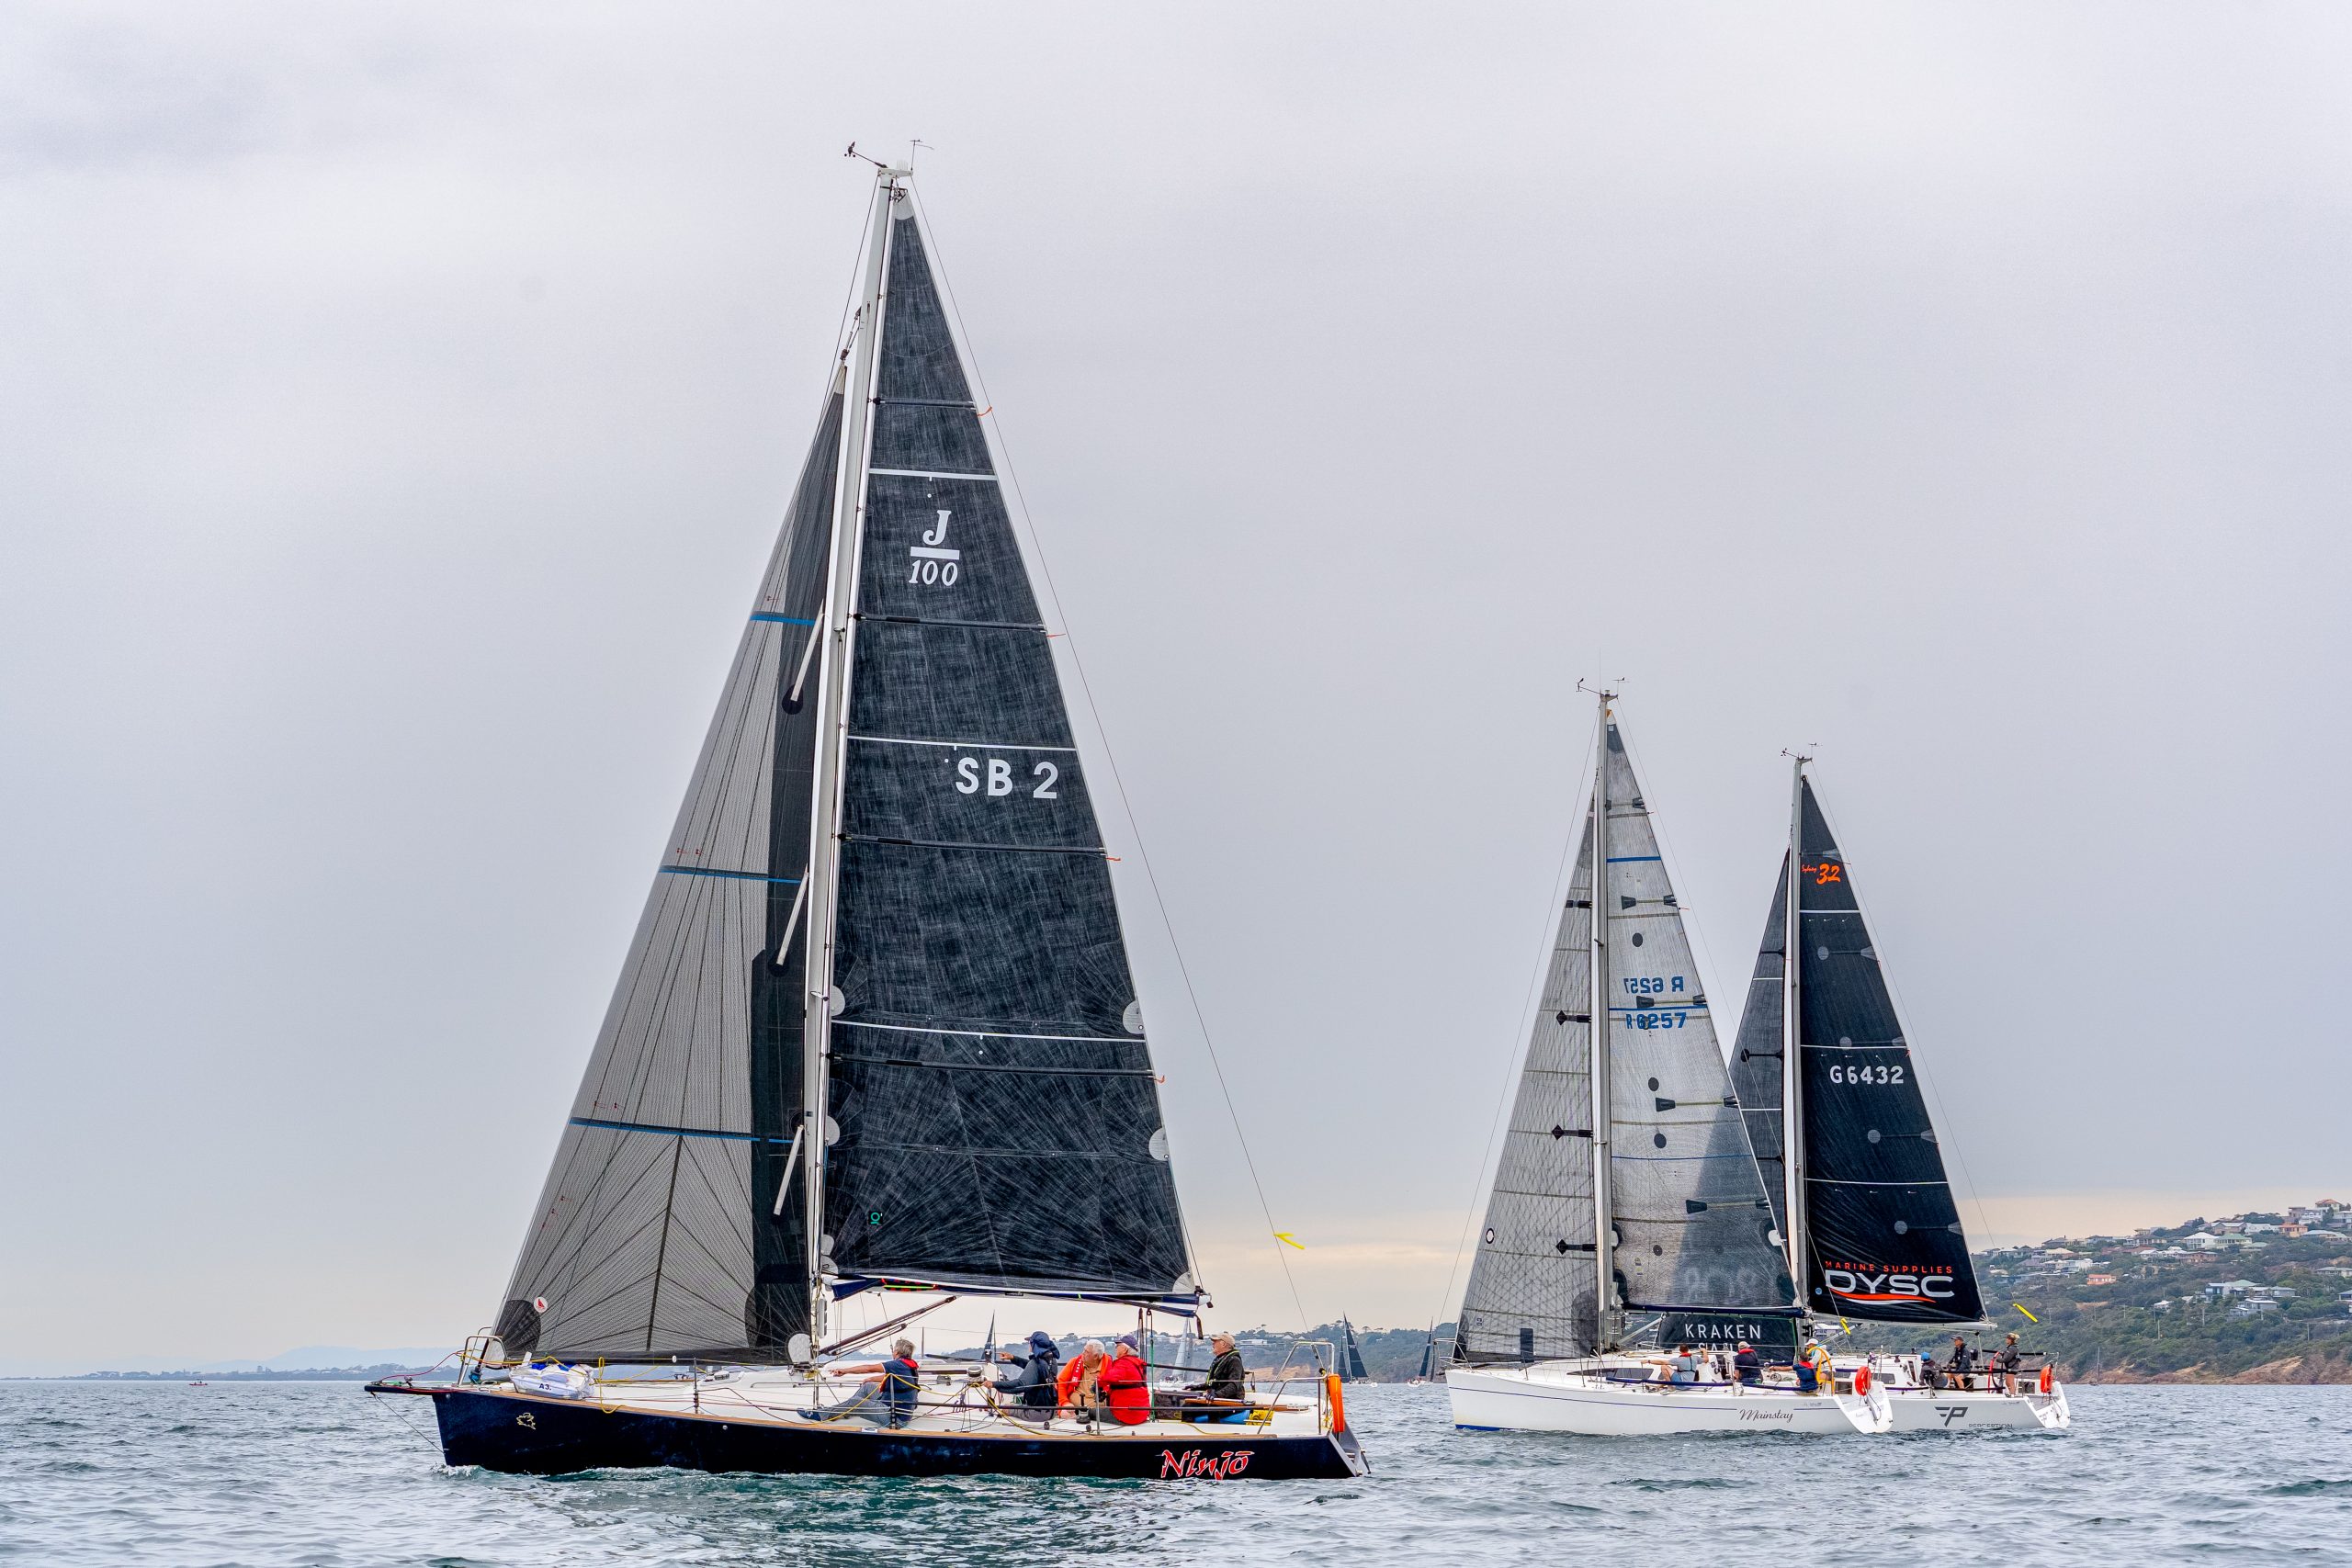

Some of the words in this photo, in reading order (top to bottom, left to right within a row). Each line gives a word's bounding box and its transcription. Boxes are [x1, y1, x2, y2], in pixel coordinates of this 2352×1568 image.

[922, 510, 952, 547] J
[909, 559, 958, 587] 100
[956, 757, 1012, 797] SB
[1033, 761, 1058, 799] 2
[1816, 863, 1841, 885] 32
[1825, 1260, 1875, 1271] MARINE
[1883, 1265, 1953, 1274] SUPPLIES
[1825, 1269, 1954, 1297] DYSC
[1685, 1324, 1761, 1339] KRAKEN
[1739, 1408, 1793, 1423] Mainstay
